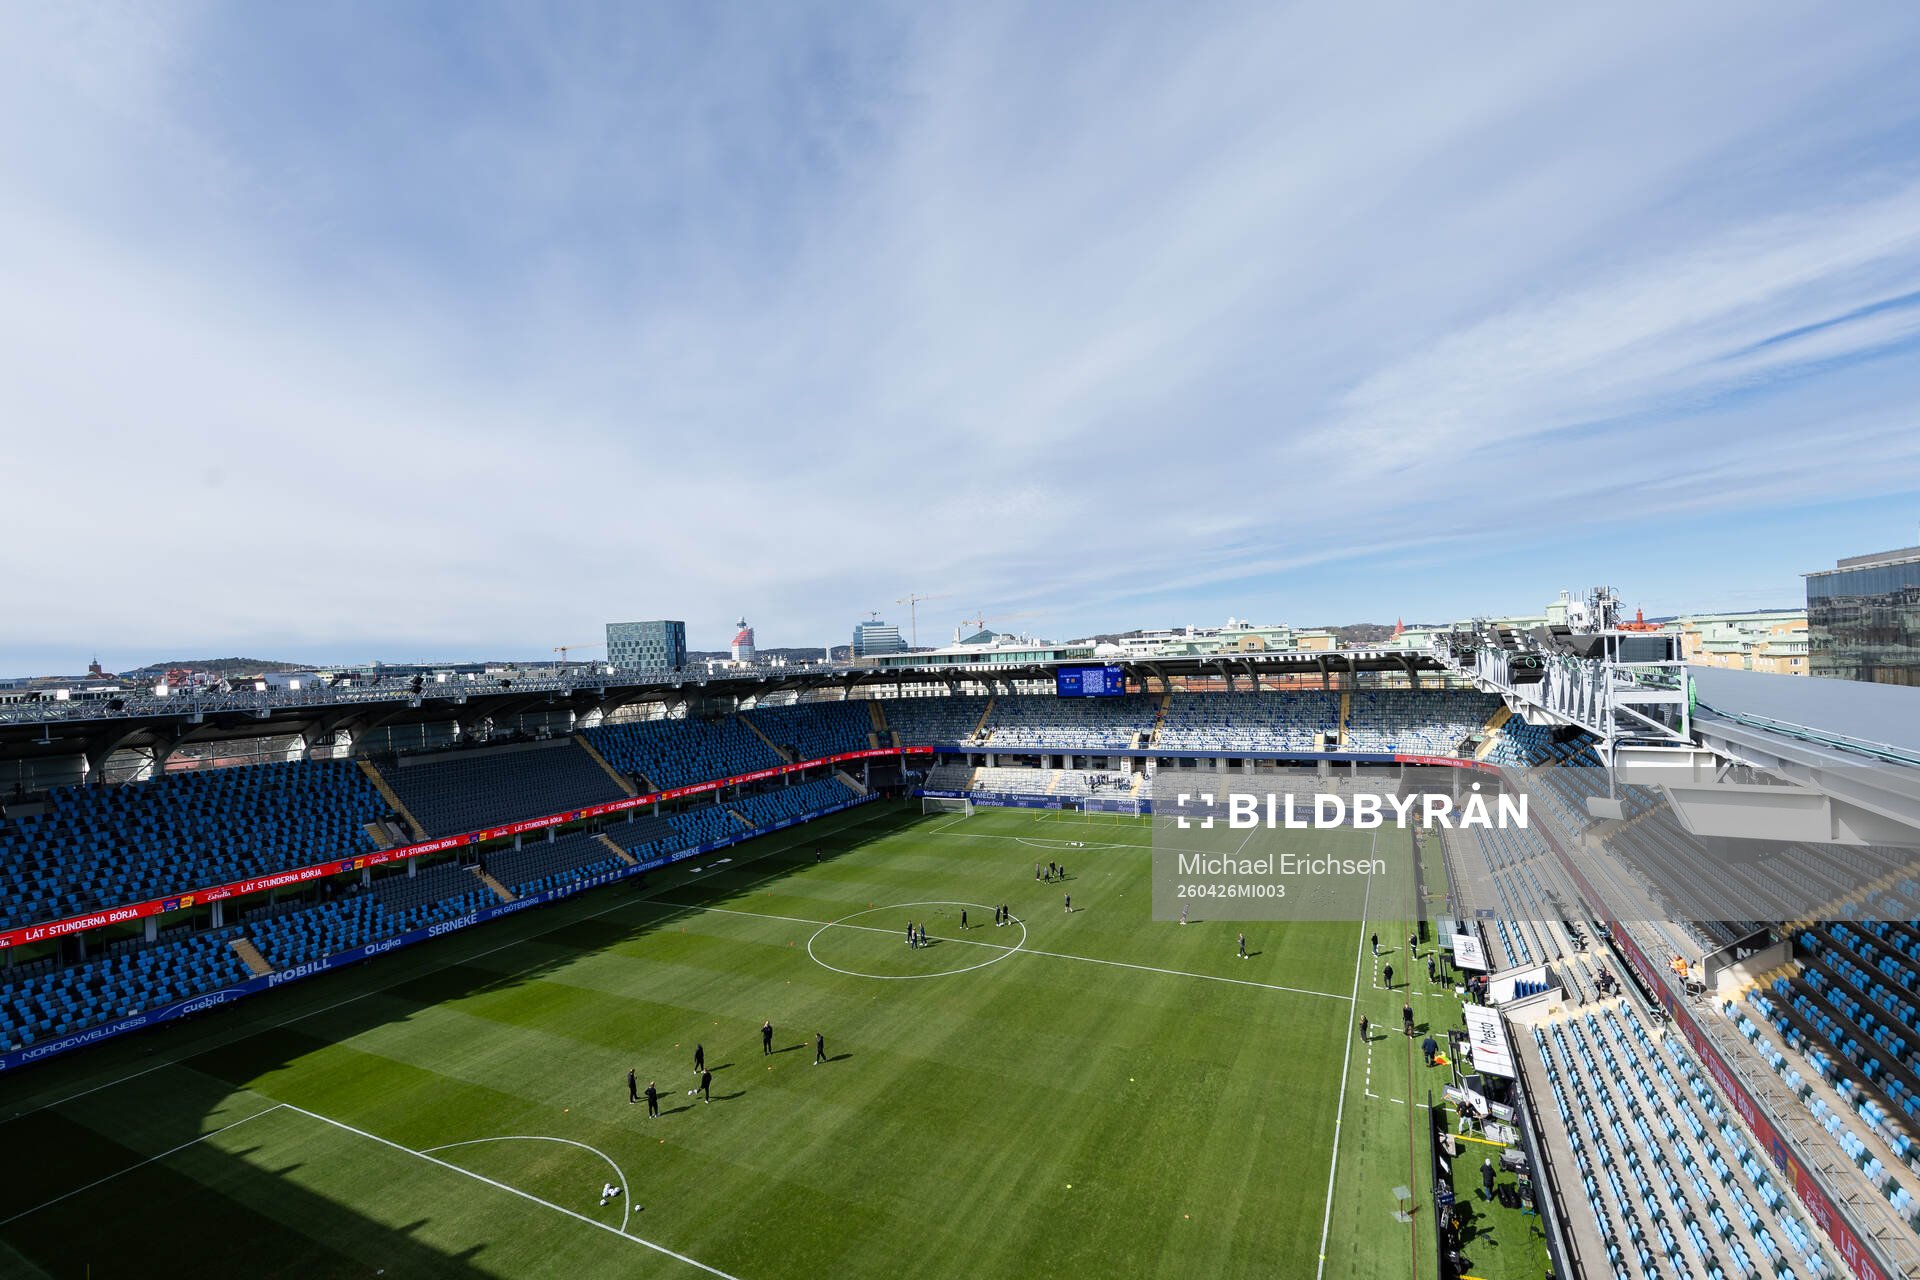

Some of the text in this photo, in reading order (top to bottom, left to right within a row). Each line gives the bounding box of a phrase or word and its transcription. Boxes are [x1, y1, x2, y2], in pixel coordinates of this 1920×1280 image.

[396, 839, 458, 858] LÅT STUNDERNA BÖRJA
[671, 846, 700, 862] SERNEKE
[240, 868, 322, 893] LÅT STUNDERNA BÖRJA
[25, 908, 138, 941] LÅT STUNDERNA BÖRJA
[428, 913, 478, 937] SERNEKE
[268, 958, 332, 988] MOBILL
[183, 993, 225, 1014] cuebid
[1840, 1229, 1858, 1267] LÅT
